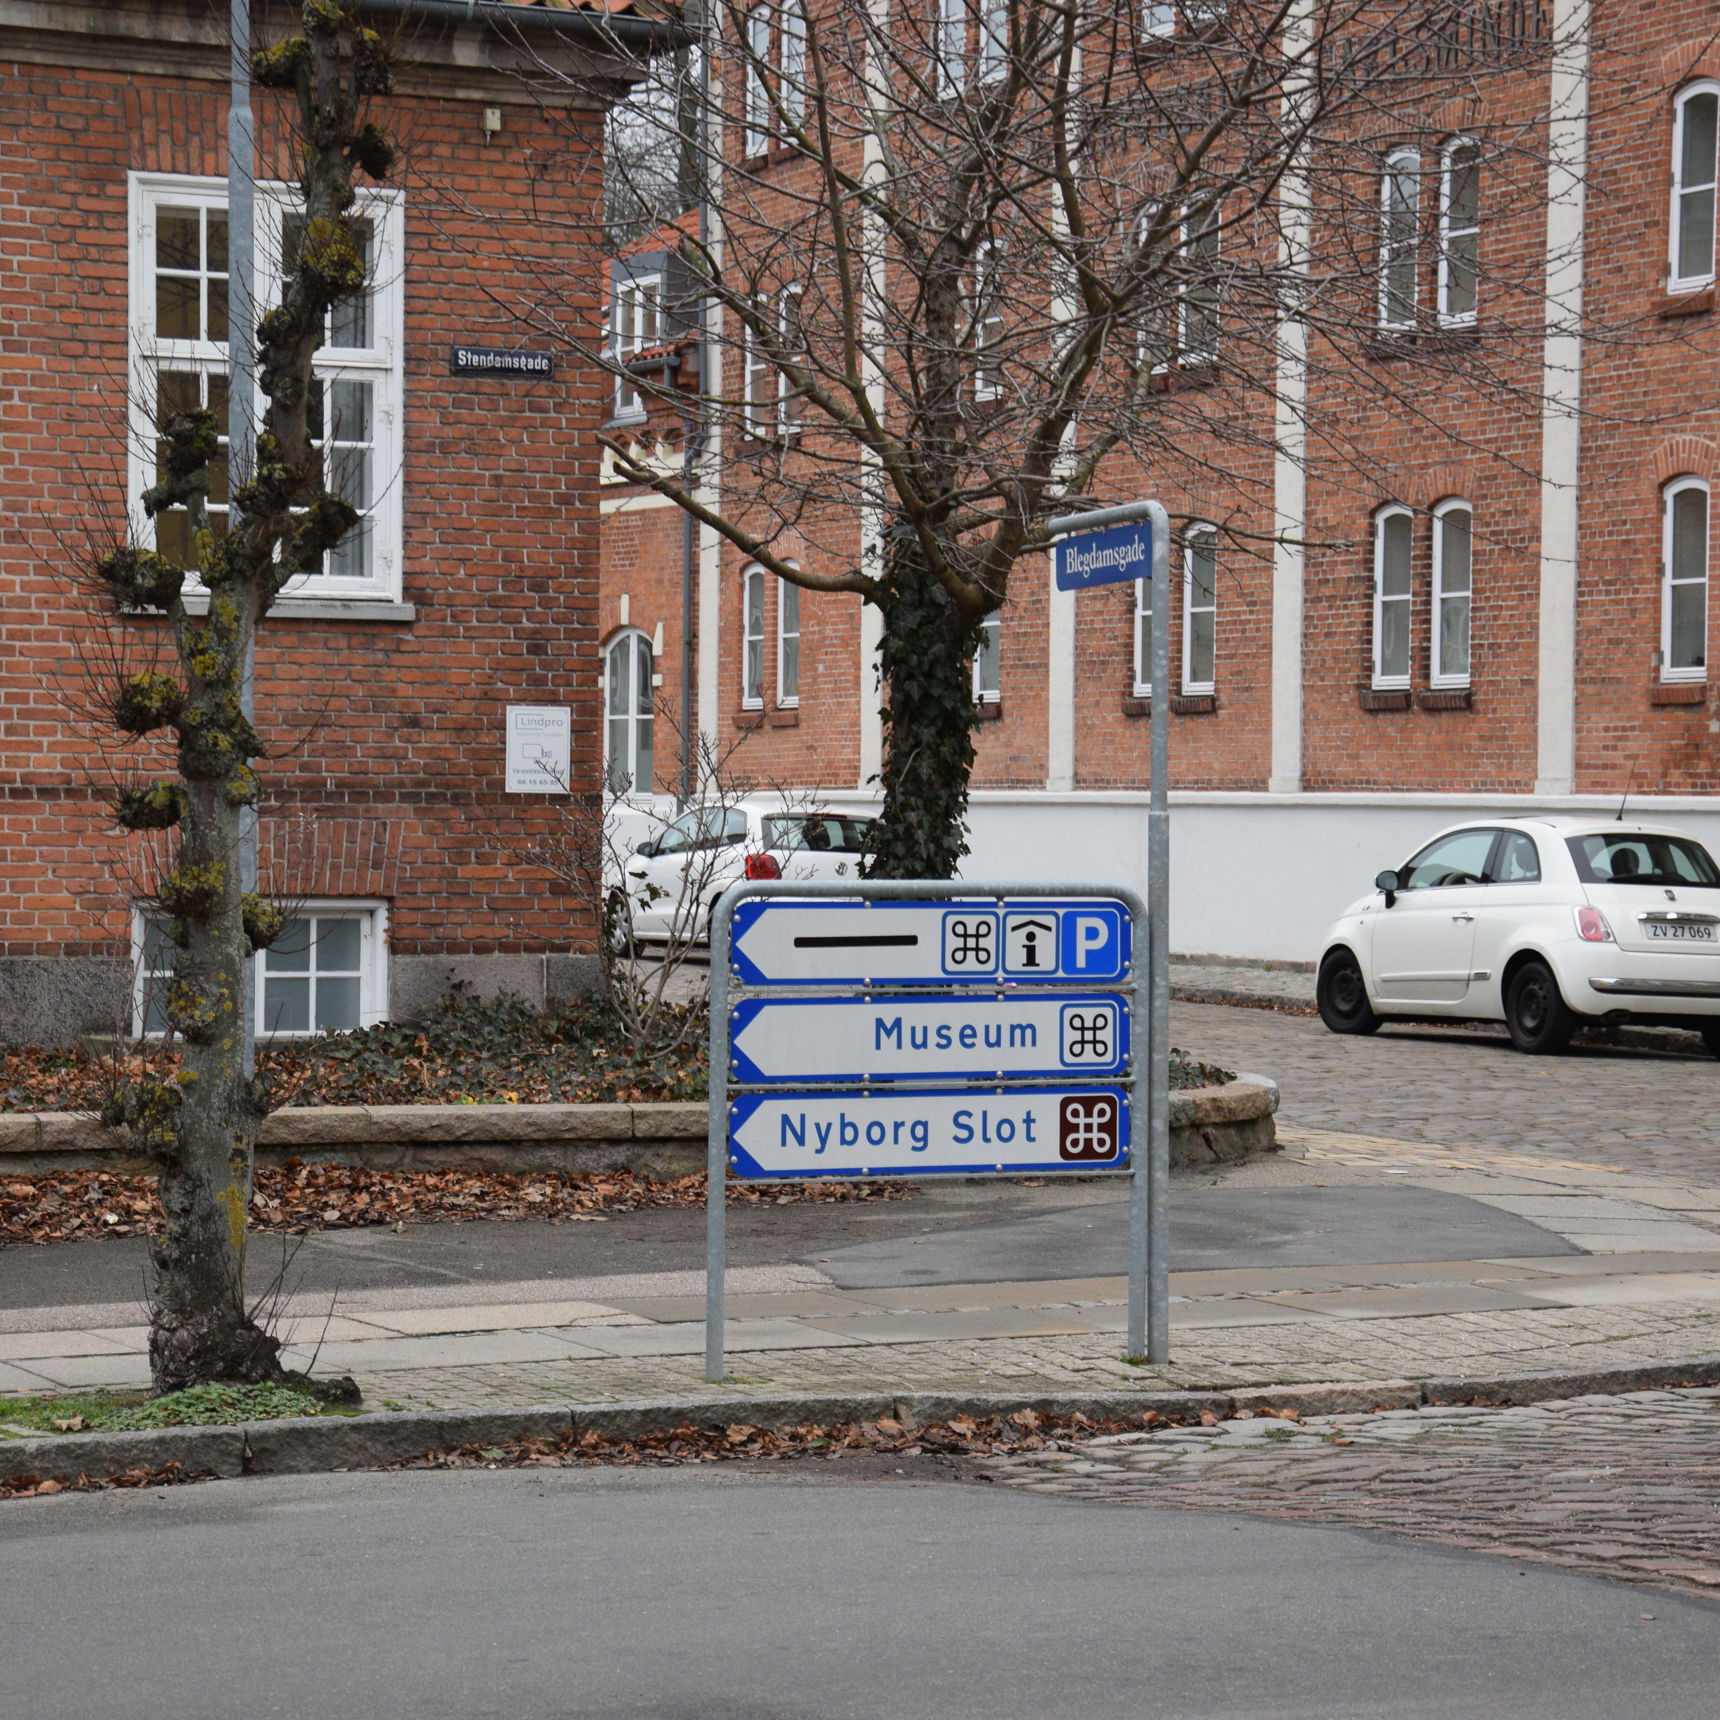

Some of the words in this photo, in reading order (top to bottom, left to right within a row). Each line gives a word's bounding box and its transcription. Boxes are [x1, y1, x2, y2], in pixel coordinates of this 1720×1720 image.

[458, 350, 549, 371] Stendamsgade
[1065, 534, 1145, 578] Blegdamsgade
[520, 717, 564, 729] Lindpro
[1076, 917, 1109, 968] P
[1651, 925, 1668, 937] ZV
[1671, 926, 1685, 938] 27
[1688, 926, 1711, 939] 069
[874, 1016, 1038, 1051] Museum
[780, 1112, 929, 1155] Nyborg
[951, 1109, 1037, 1145] Slot
